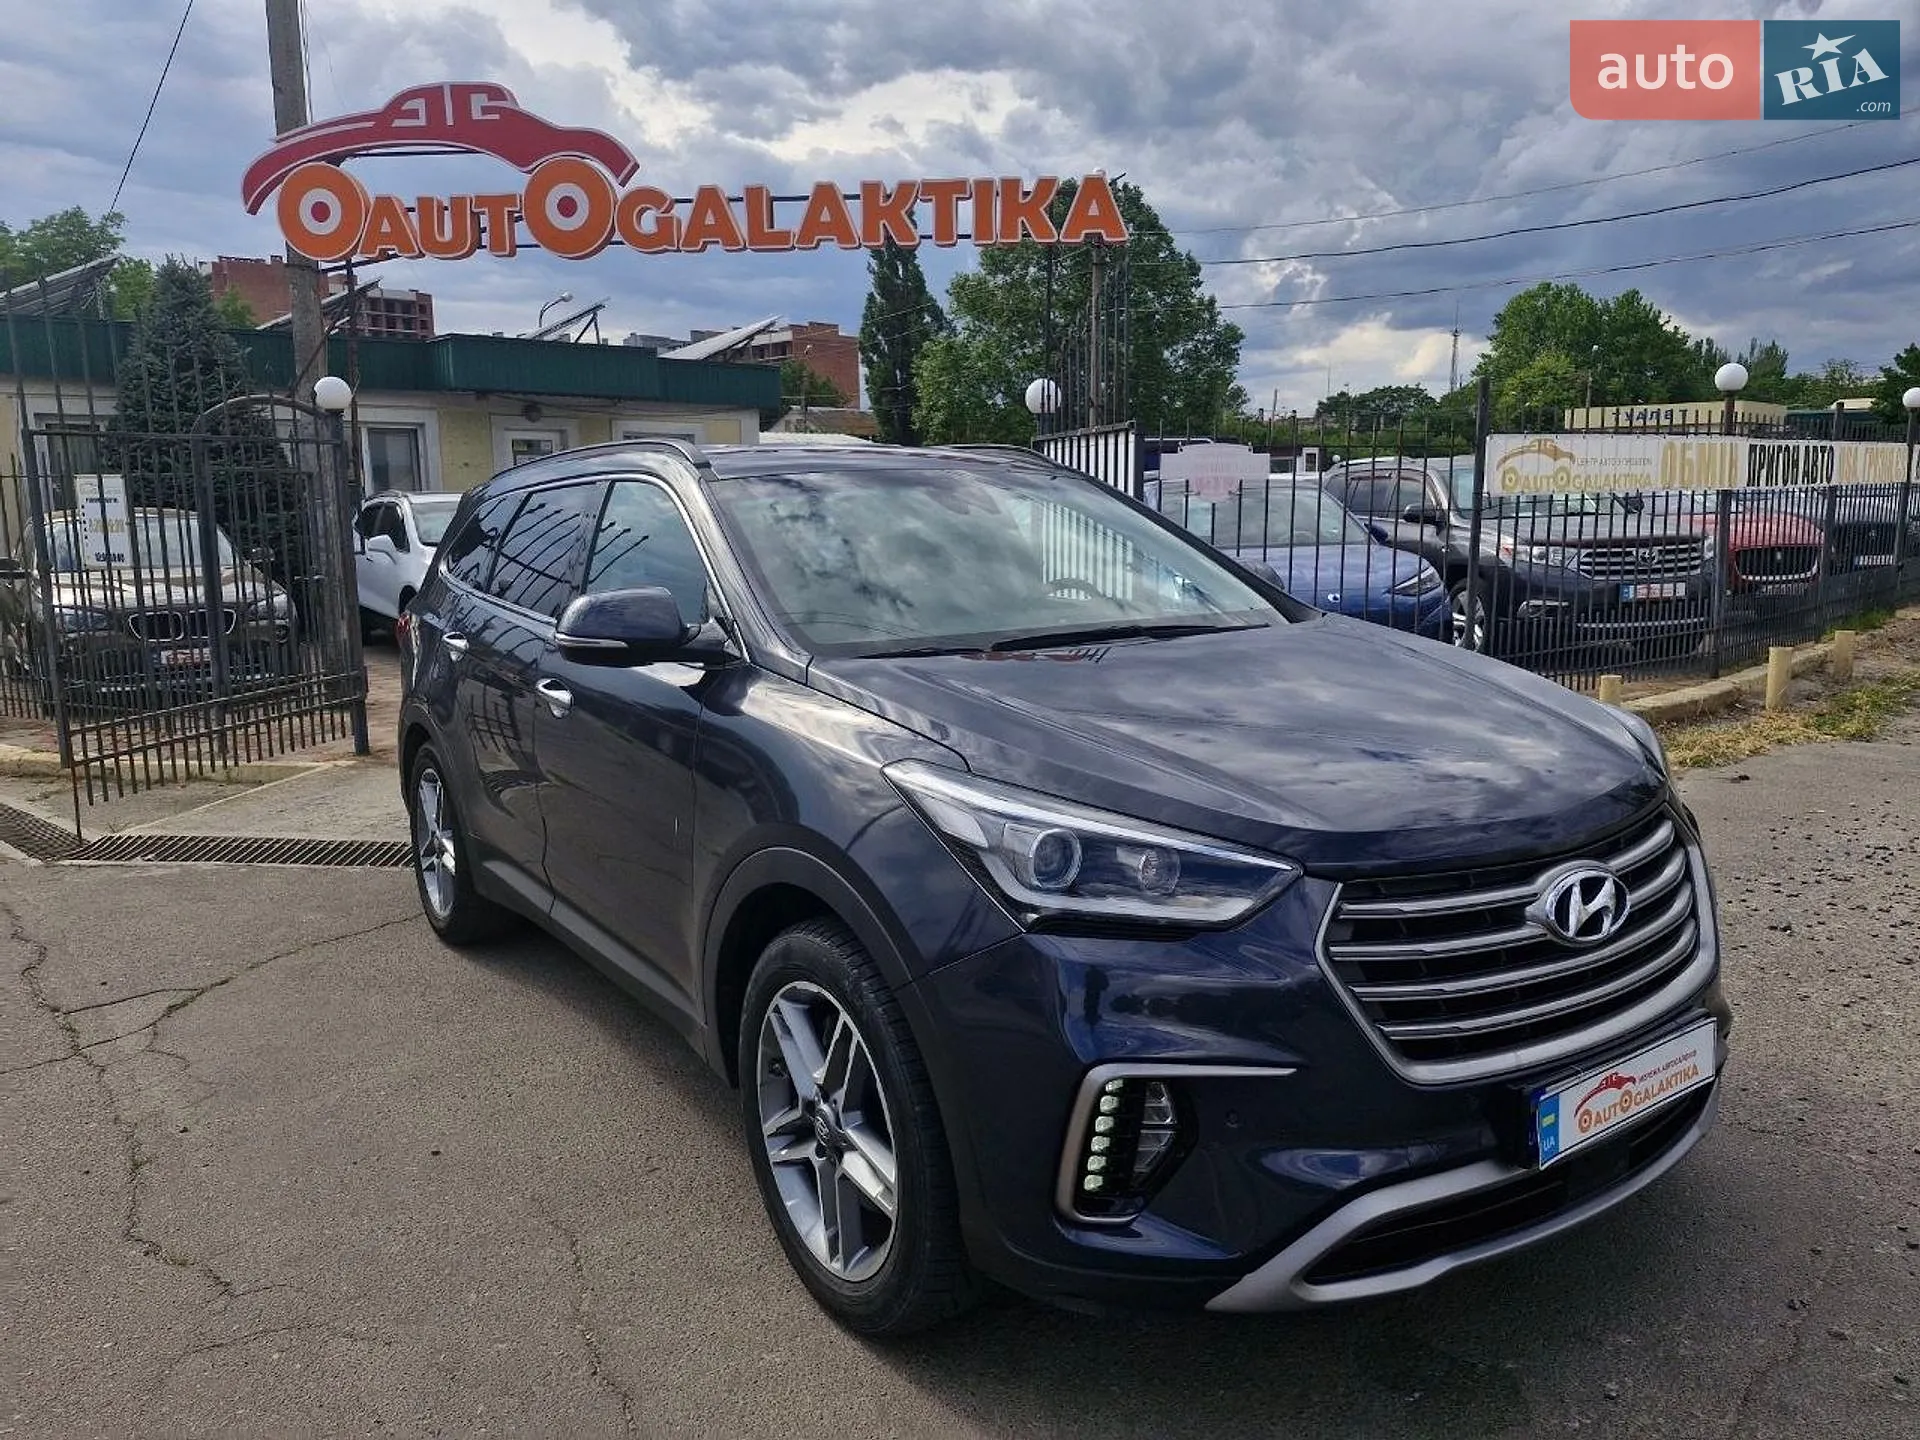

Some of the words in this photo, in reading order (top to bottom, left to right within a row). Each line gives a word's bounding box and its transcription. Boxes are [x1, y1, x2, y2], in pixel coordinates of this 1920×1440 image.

[1746, 443, 1797, 488] ПРИГОН
[1802, 445, 1835, 486] АВТО
[1543, 1139, 1556, 1150] UA
